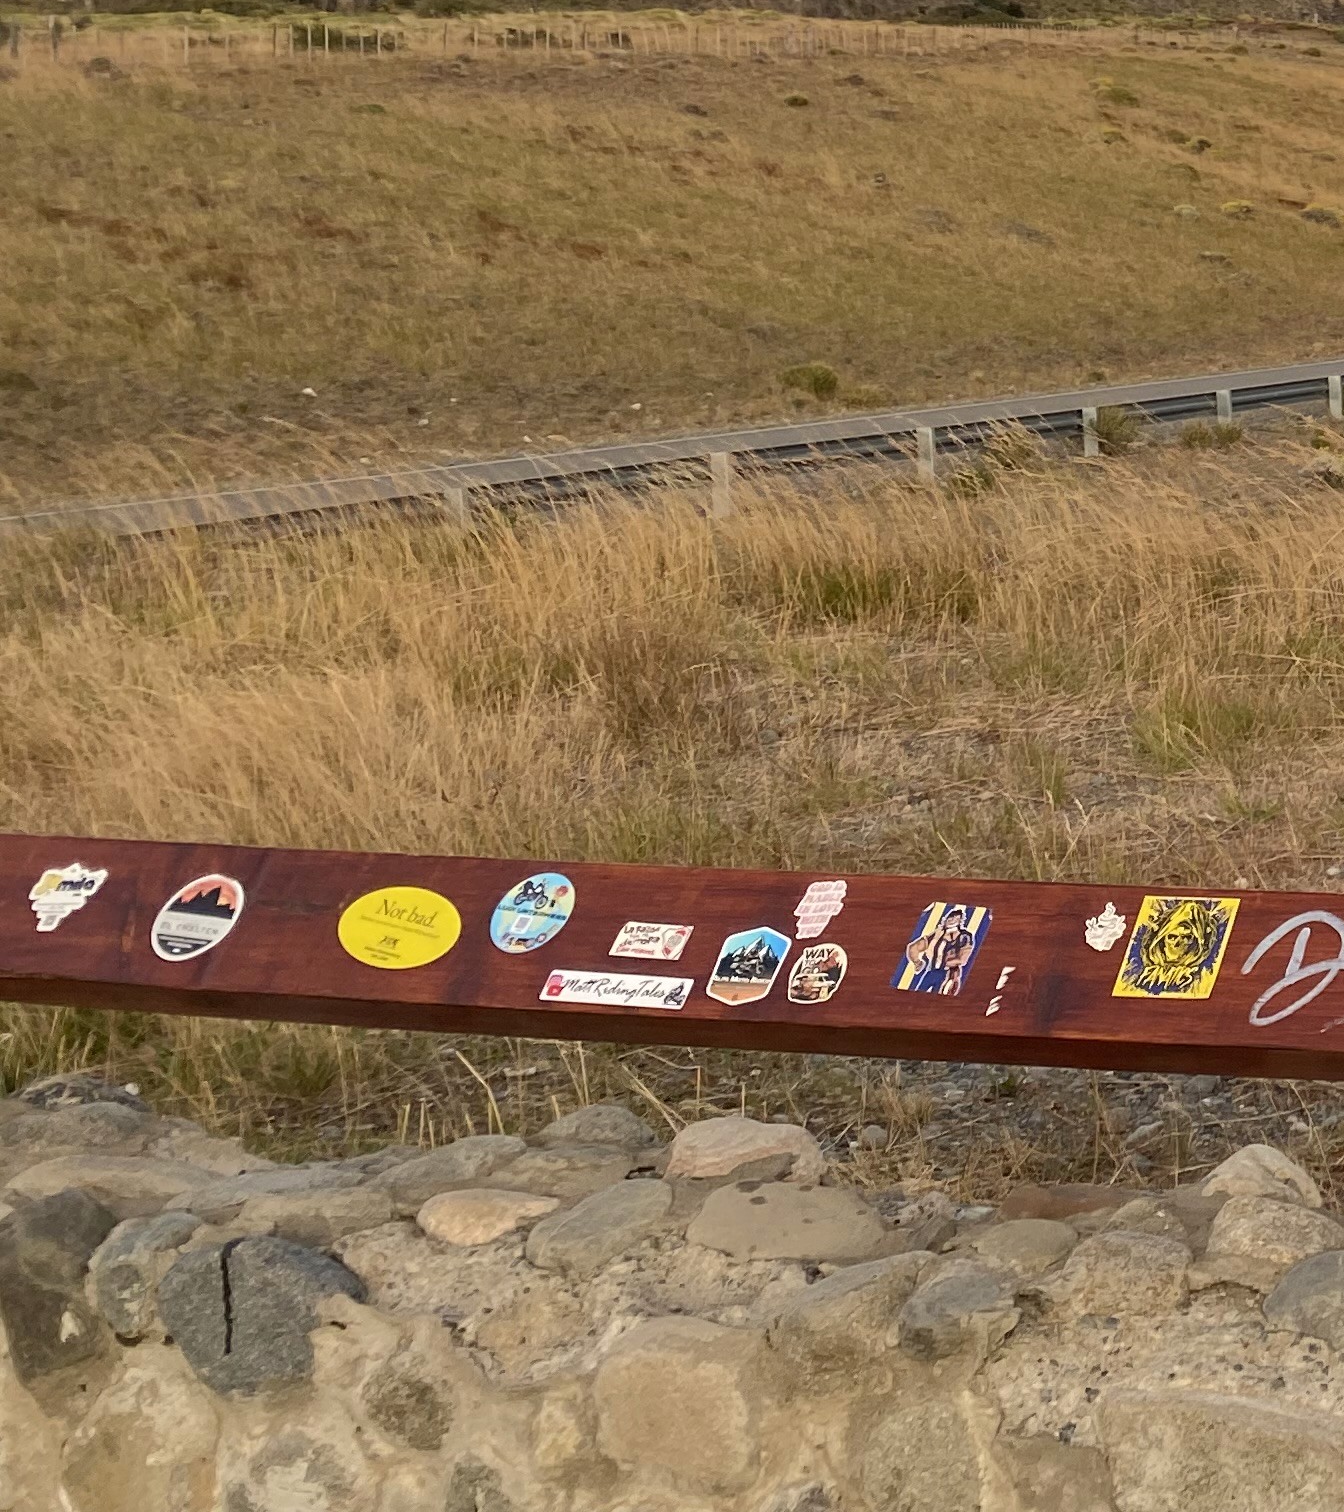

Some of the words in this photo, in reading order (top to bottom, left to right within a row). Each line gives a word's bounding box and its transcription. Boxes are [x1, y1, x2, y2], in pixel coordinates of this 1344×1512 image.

[375, 898, 407, 920] Not
[406, 906, 438, 928] bad.
[805, 948, 834, 959] WAY
